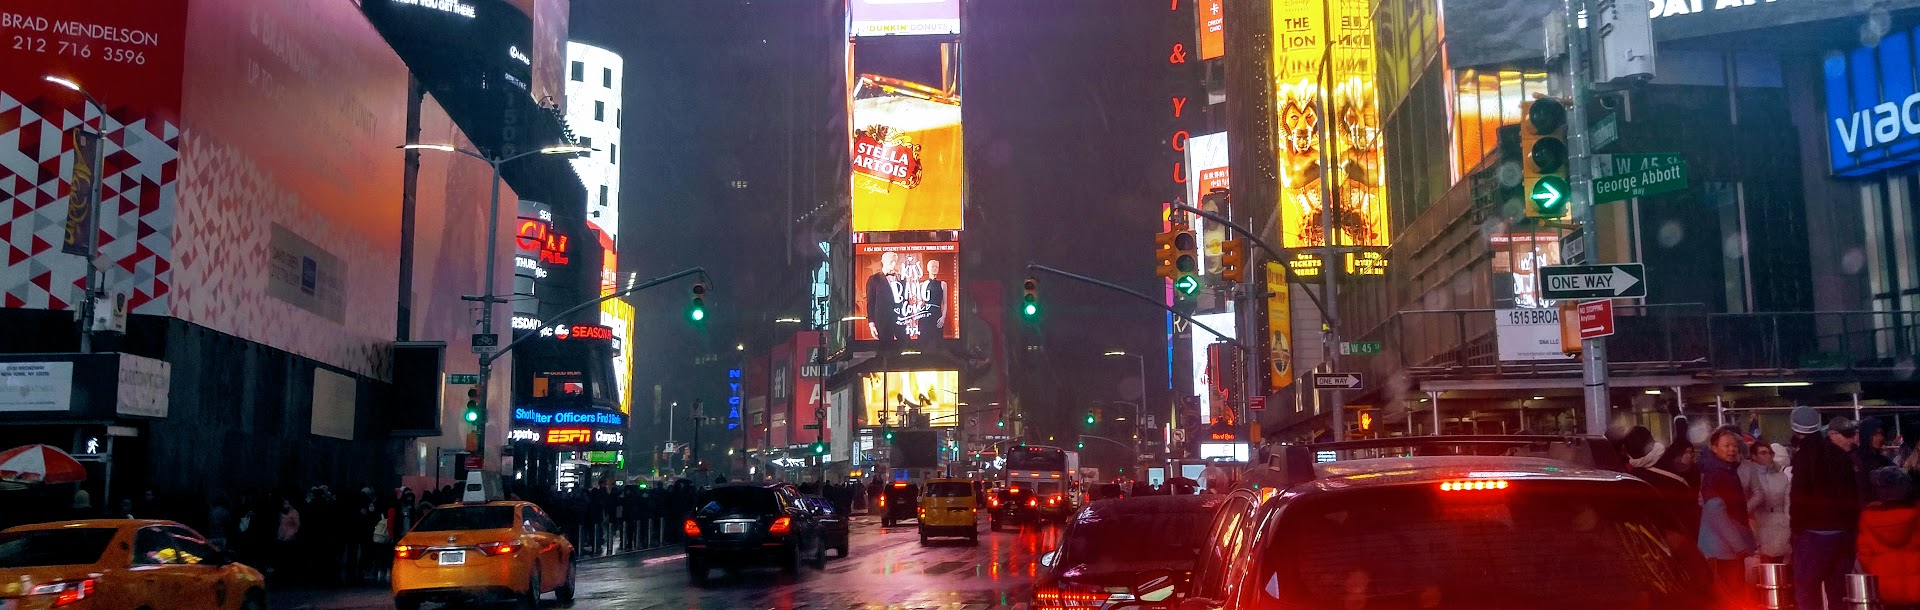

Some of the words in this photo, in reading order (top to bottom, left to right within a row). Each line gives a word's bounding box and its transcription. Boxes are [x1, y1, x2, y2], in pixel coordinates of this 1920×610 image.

[910, 23, 948, 31] DONUTS
[1207, 18, 1223, 26] CREDIT
[1284, 17, 1309, 29] THE
[2, 12, 49, 32] BRAD
[53, 20, 158, 47] MENDELSON
[1209, 25, 1222, 33] CARD
[13, 35, 47, 53] 212
[58, 41, 91, 58] 716
[103, 47, 145, 65] 3596
[1281, 34, 1316, 53] LION
[857, 142, 909, 166] STELLA
[853, 154, 908, 178] ARTOIS
[1616, 157, 1631, 175] W
[1596, 176, 1638, 195] George
[1641, 165, 1681, 186] Abbott
[1632, 187, 1645, 197] Way
[1290, 259, 1322, 267] TICKETS
[1551, 276, 1580, 290] ONE
[1584, 275, 1613, 288] WAY
[890, 280, 931, 304] BANG
[1509, 311, 1529, 324] 1515
[1350, 343, 1358, 353] W
[1361, 343, 1372, 353] 45
[555, 411, 596, 423] Officers
[547, 429, 591, 442] ESPN
